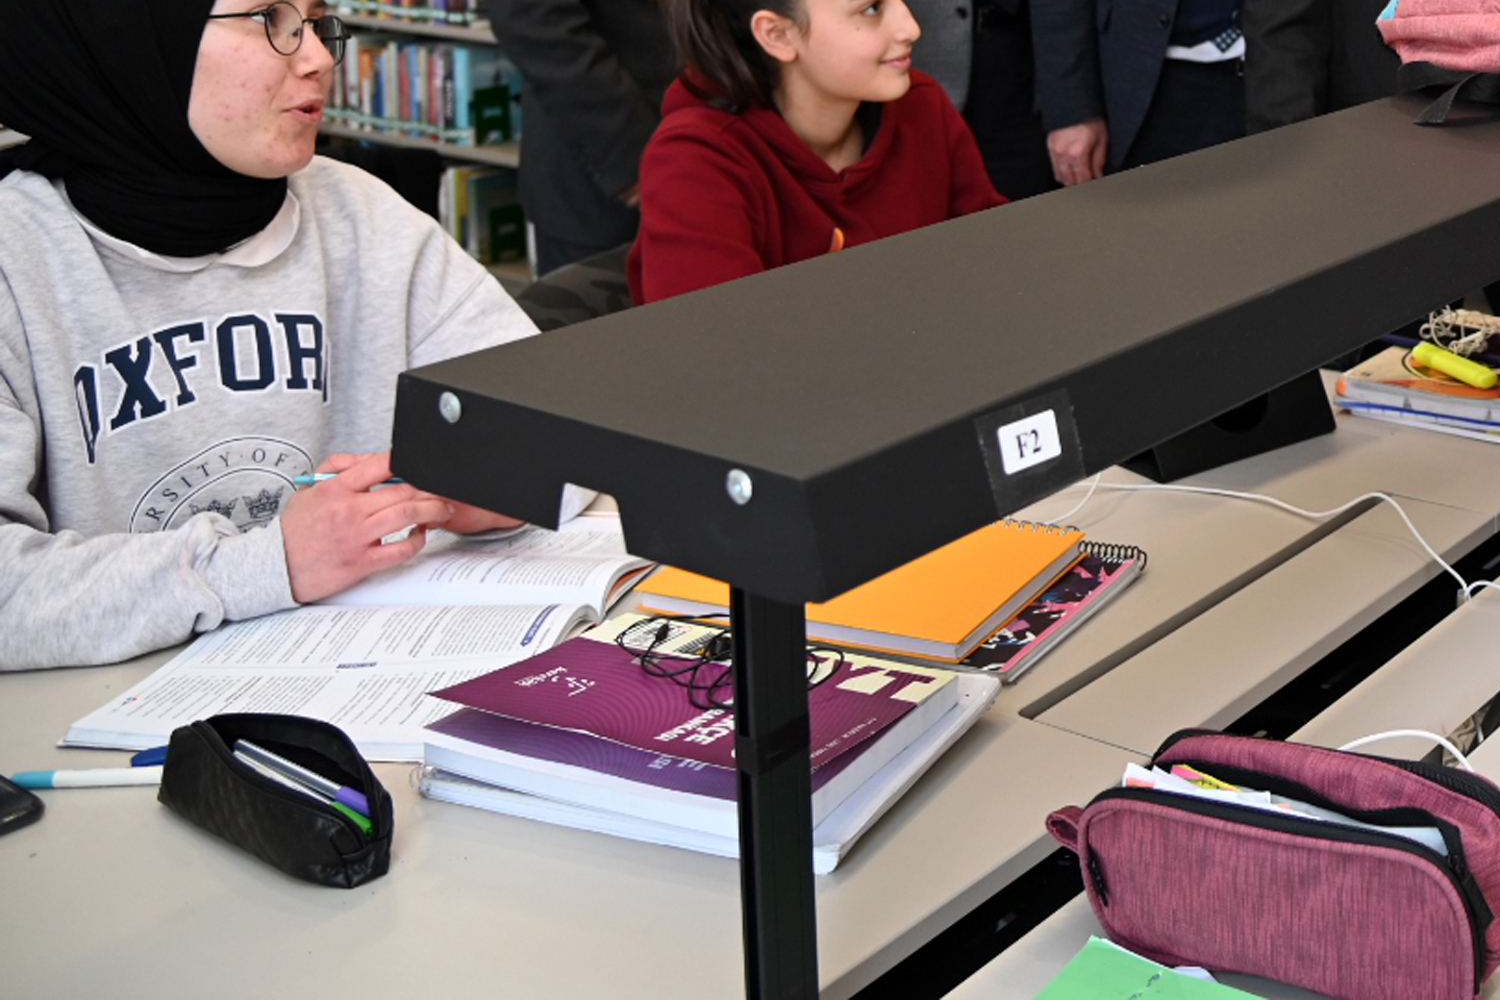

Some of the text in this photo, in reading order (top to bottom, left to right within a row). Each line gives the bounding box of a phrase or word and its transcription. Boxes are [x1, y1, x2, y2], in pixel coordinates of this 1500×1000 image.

[74, 314, 331, 464] OXFOR
[252, 447, 288, 466] OF
[1016, 427, 1043, 460] F2
